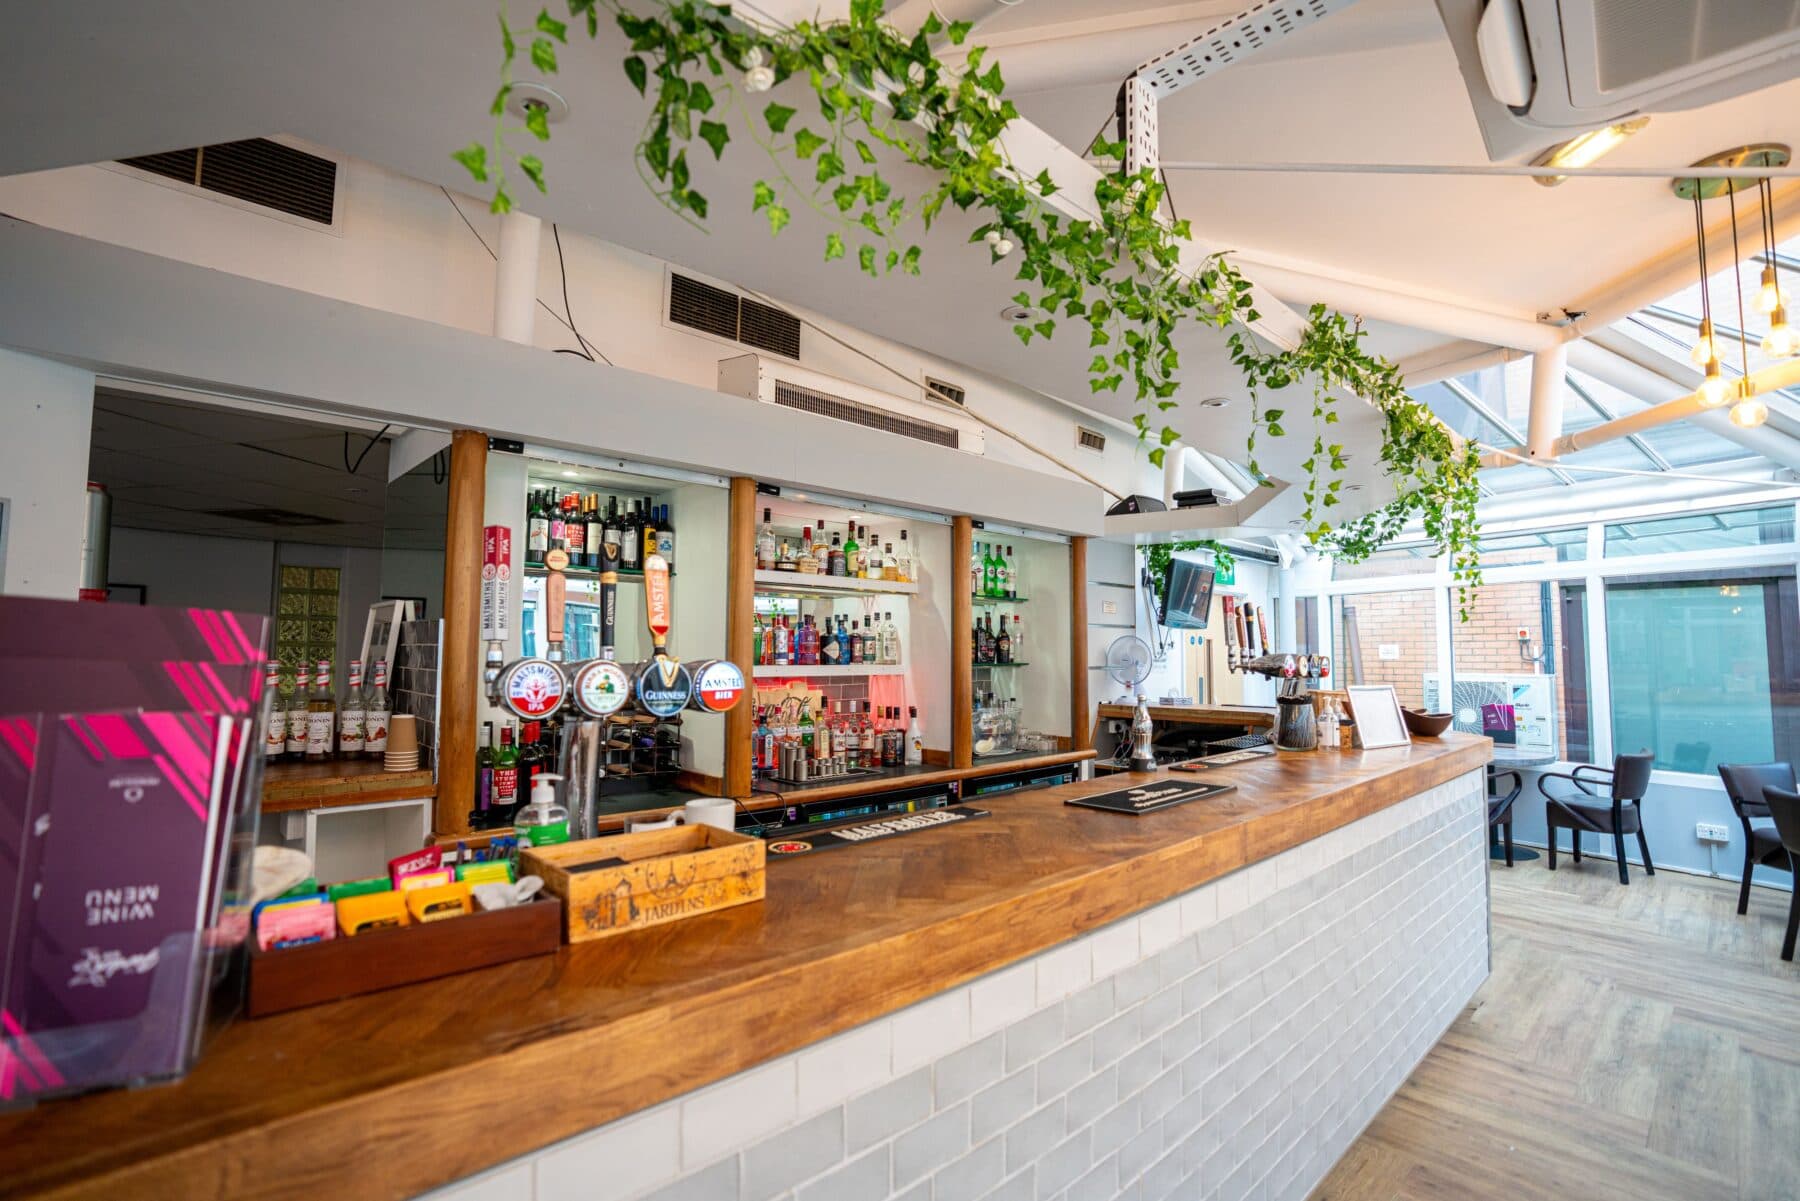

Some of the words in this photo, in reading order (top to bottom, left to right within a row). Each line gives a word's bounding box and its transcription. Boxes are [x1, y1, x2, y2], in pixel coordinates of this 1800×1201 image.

[605, 590, 614, 625] GUINNESS
[653, 573, 665, 622] AMSTEL
[705, 678, 740, 689] AMSTEL
[715, 690, 733, 700] BIER
[528, 702, 545, 711] IPA
[645, 690, 687, 701] GUINNESS
[85, 885, 160, 908] MENU
[86, 902, 154, 926] WINE
[643, 896, 706, 924] JARDINS
